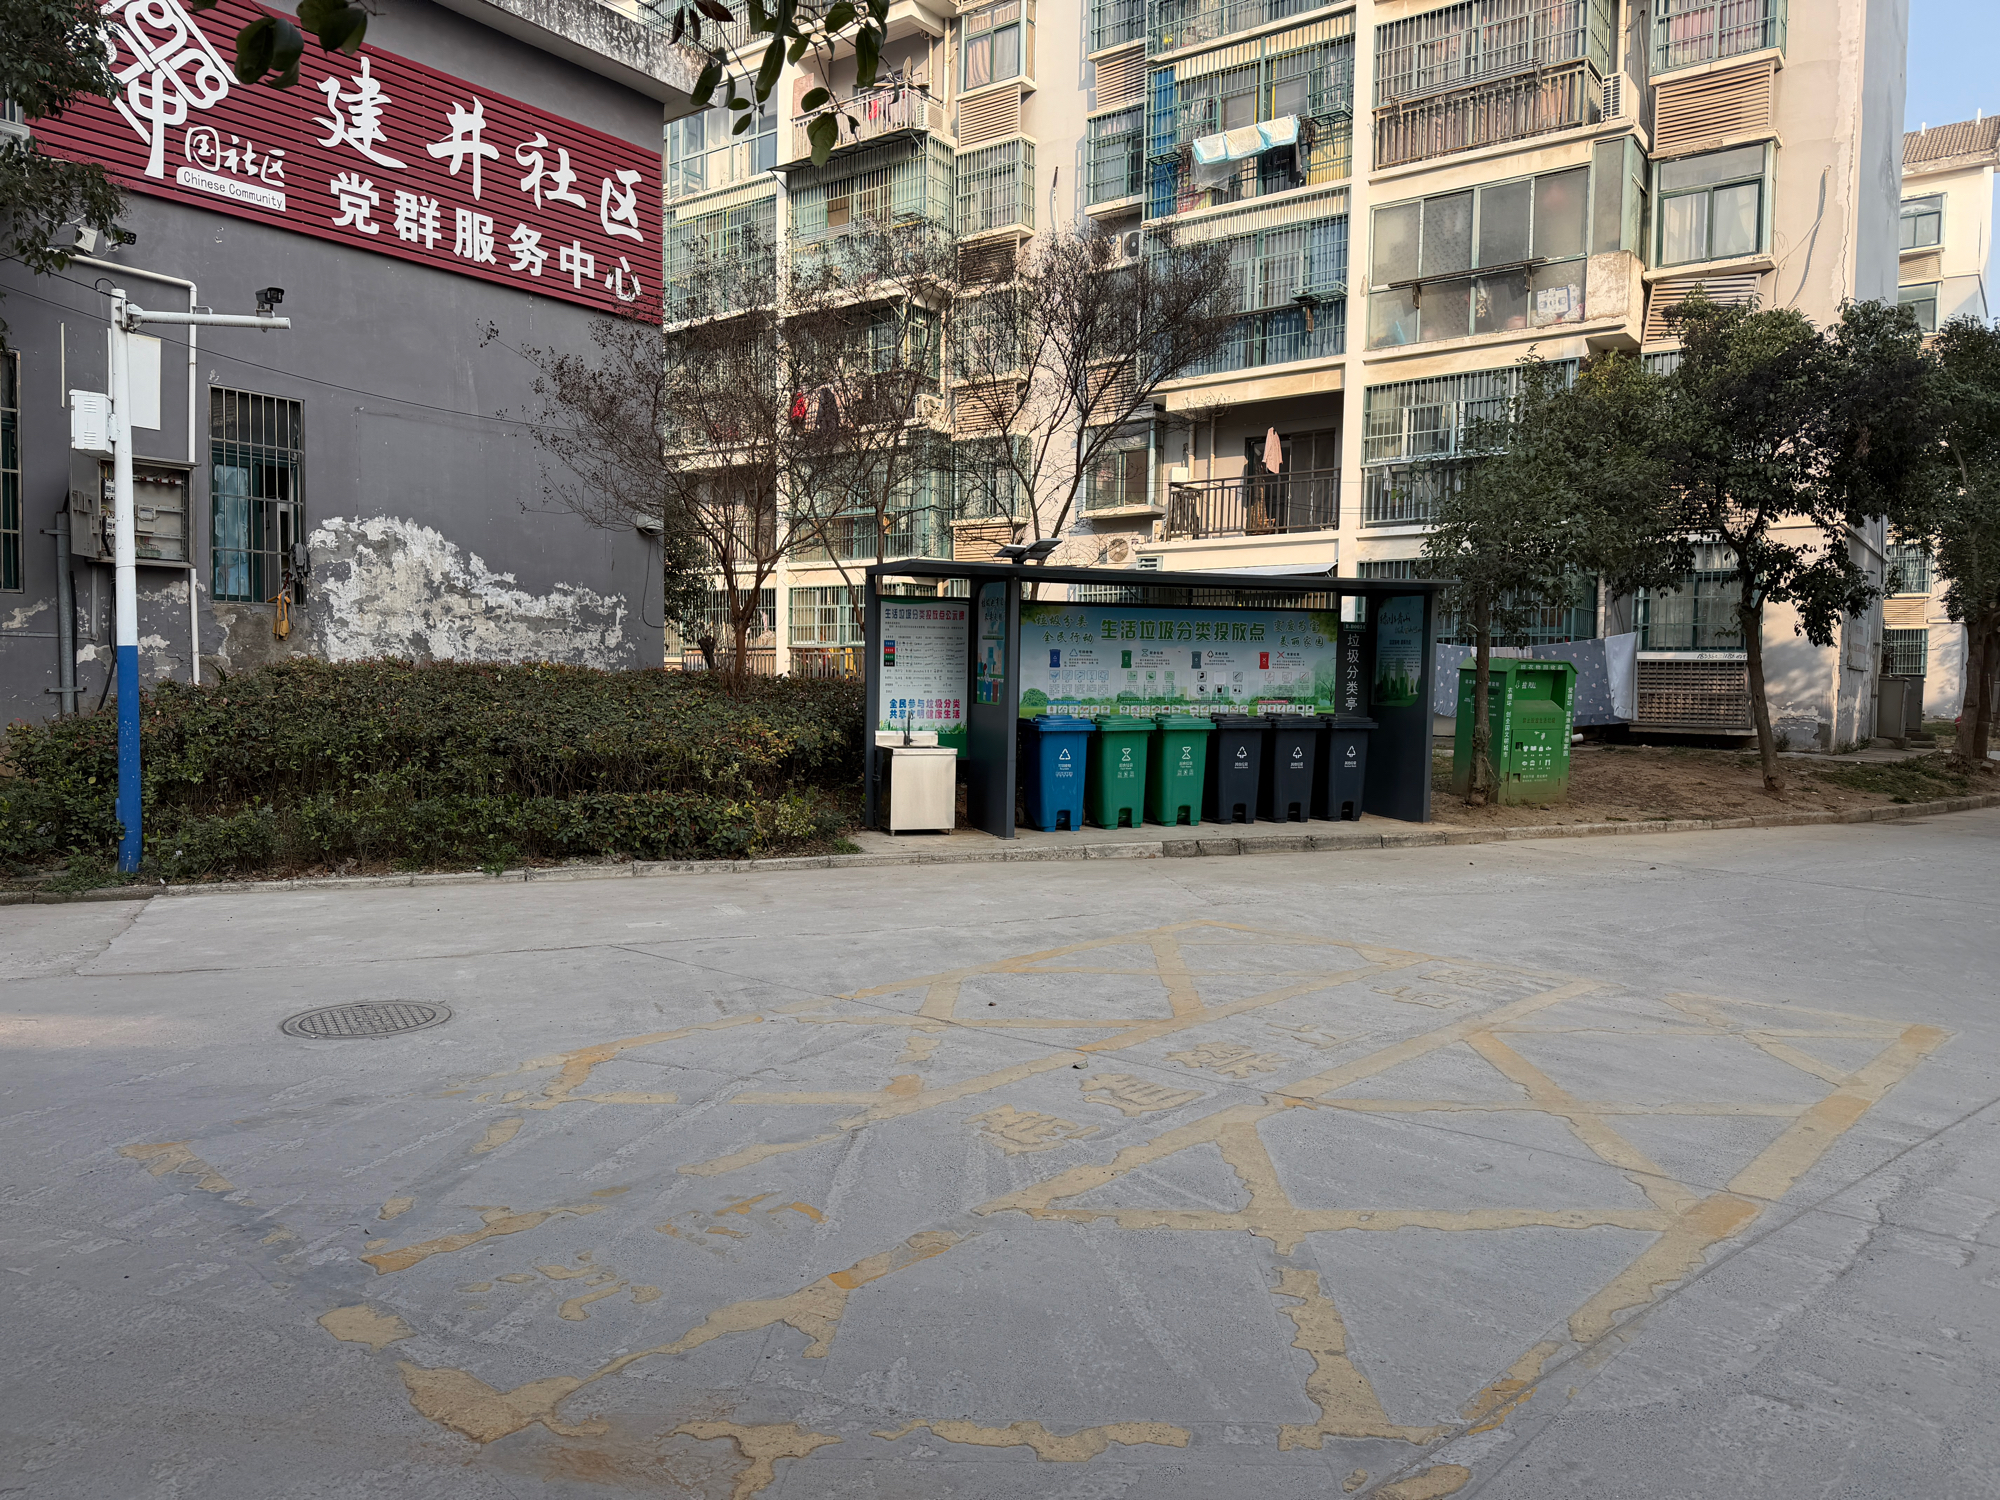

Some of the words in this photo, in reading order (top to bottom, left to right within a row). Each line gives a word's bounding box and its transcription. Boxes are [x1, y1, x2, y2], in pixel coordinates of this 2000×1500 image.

[312, 56, 644, 243] 建井社区
[184, 170, 226, 193] Chinese
[228, 182, 283, 209] Community
[330, 171, 642, 302] 党群服务中心
[1035, 614, 1089, 628] 垃圾分类
[1100, 619, 1265, 642] 生活垃圾分类投放点
[1042, 630, 1094, 643] 全民行动
[1279, 635, 1325, 648] 美丽家园
[1345, 633, 1360, 711] 垃圾分类亭
[889, 698, 961, 709] 全民参与垃圾分类
